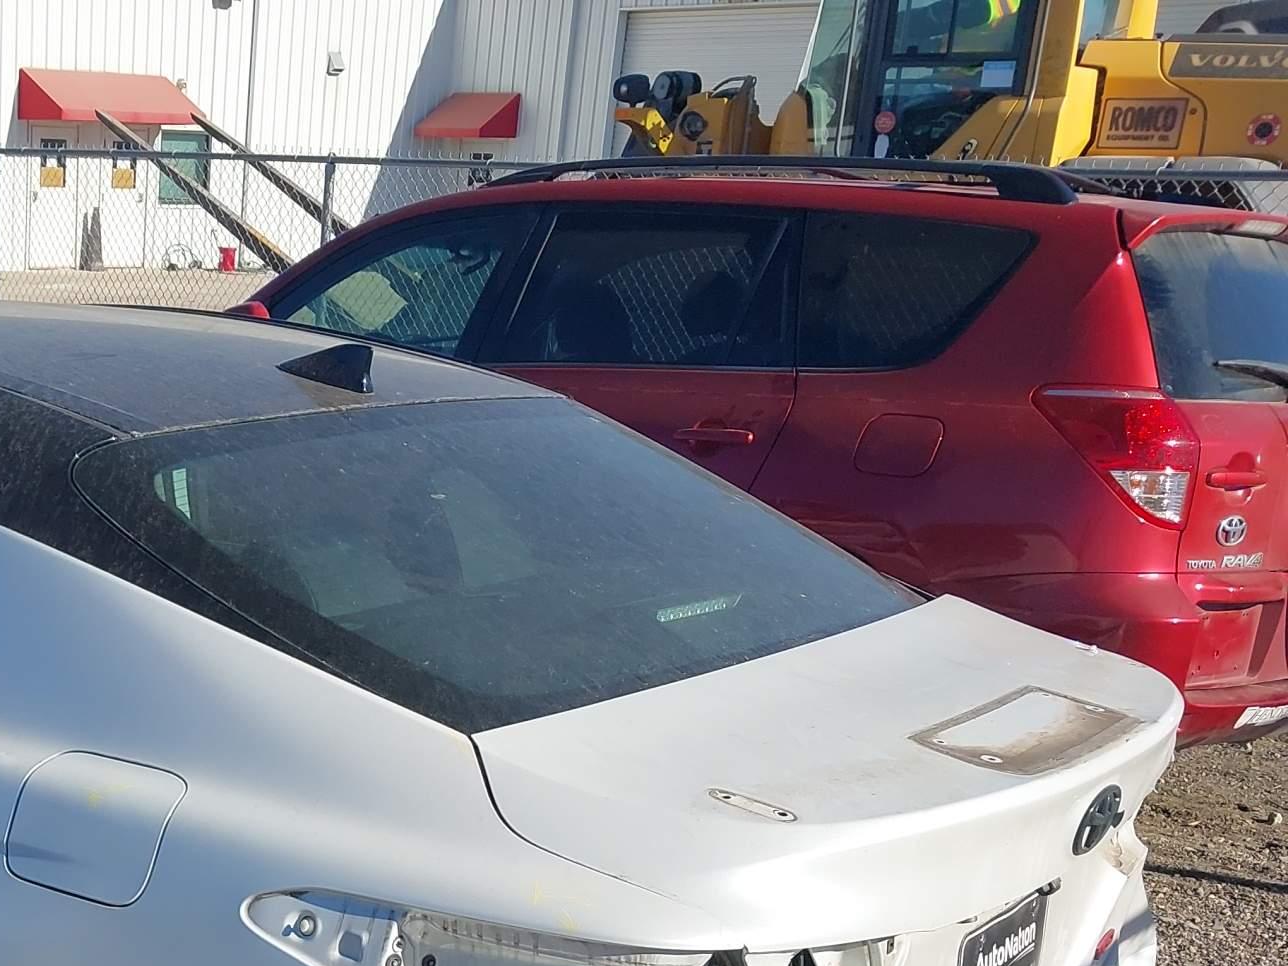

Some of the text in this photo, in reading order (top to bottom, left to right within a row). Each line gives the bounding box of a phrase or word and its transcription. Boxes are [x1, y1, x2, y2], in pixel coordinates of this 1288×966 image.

[1109, 106, 1178, 132] ROMCO
[1186, 552, 1264, 569] TOYOTA RAV4
